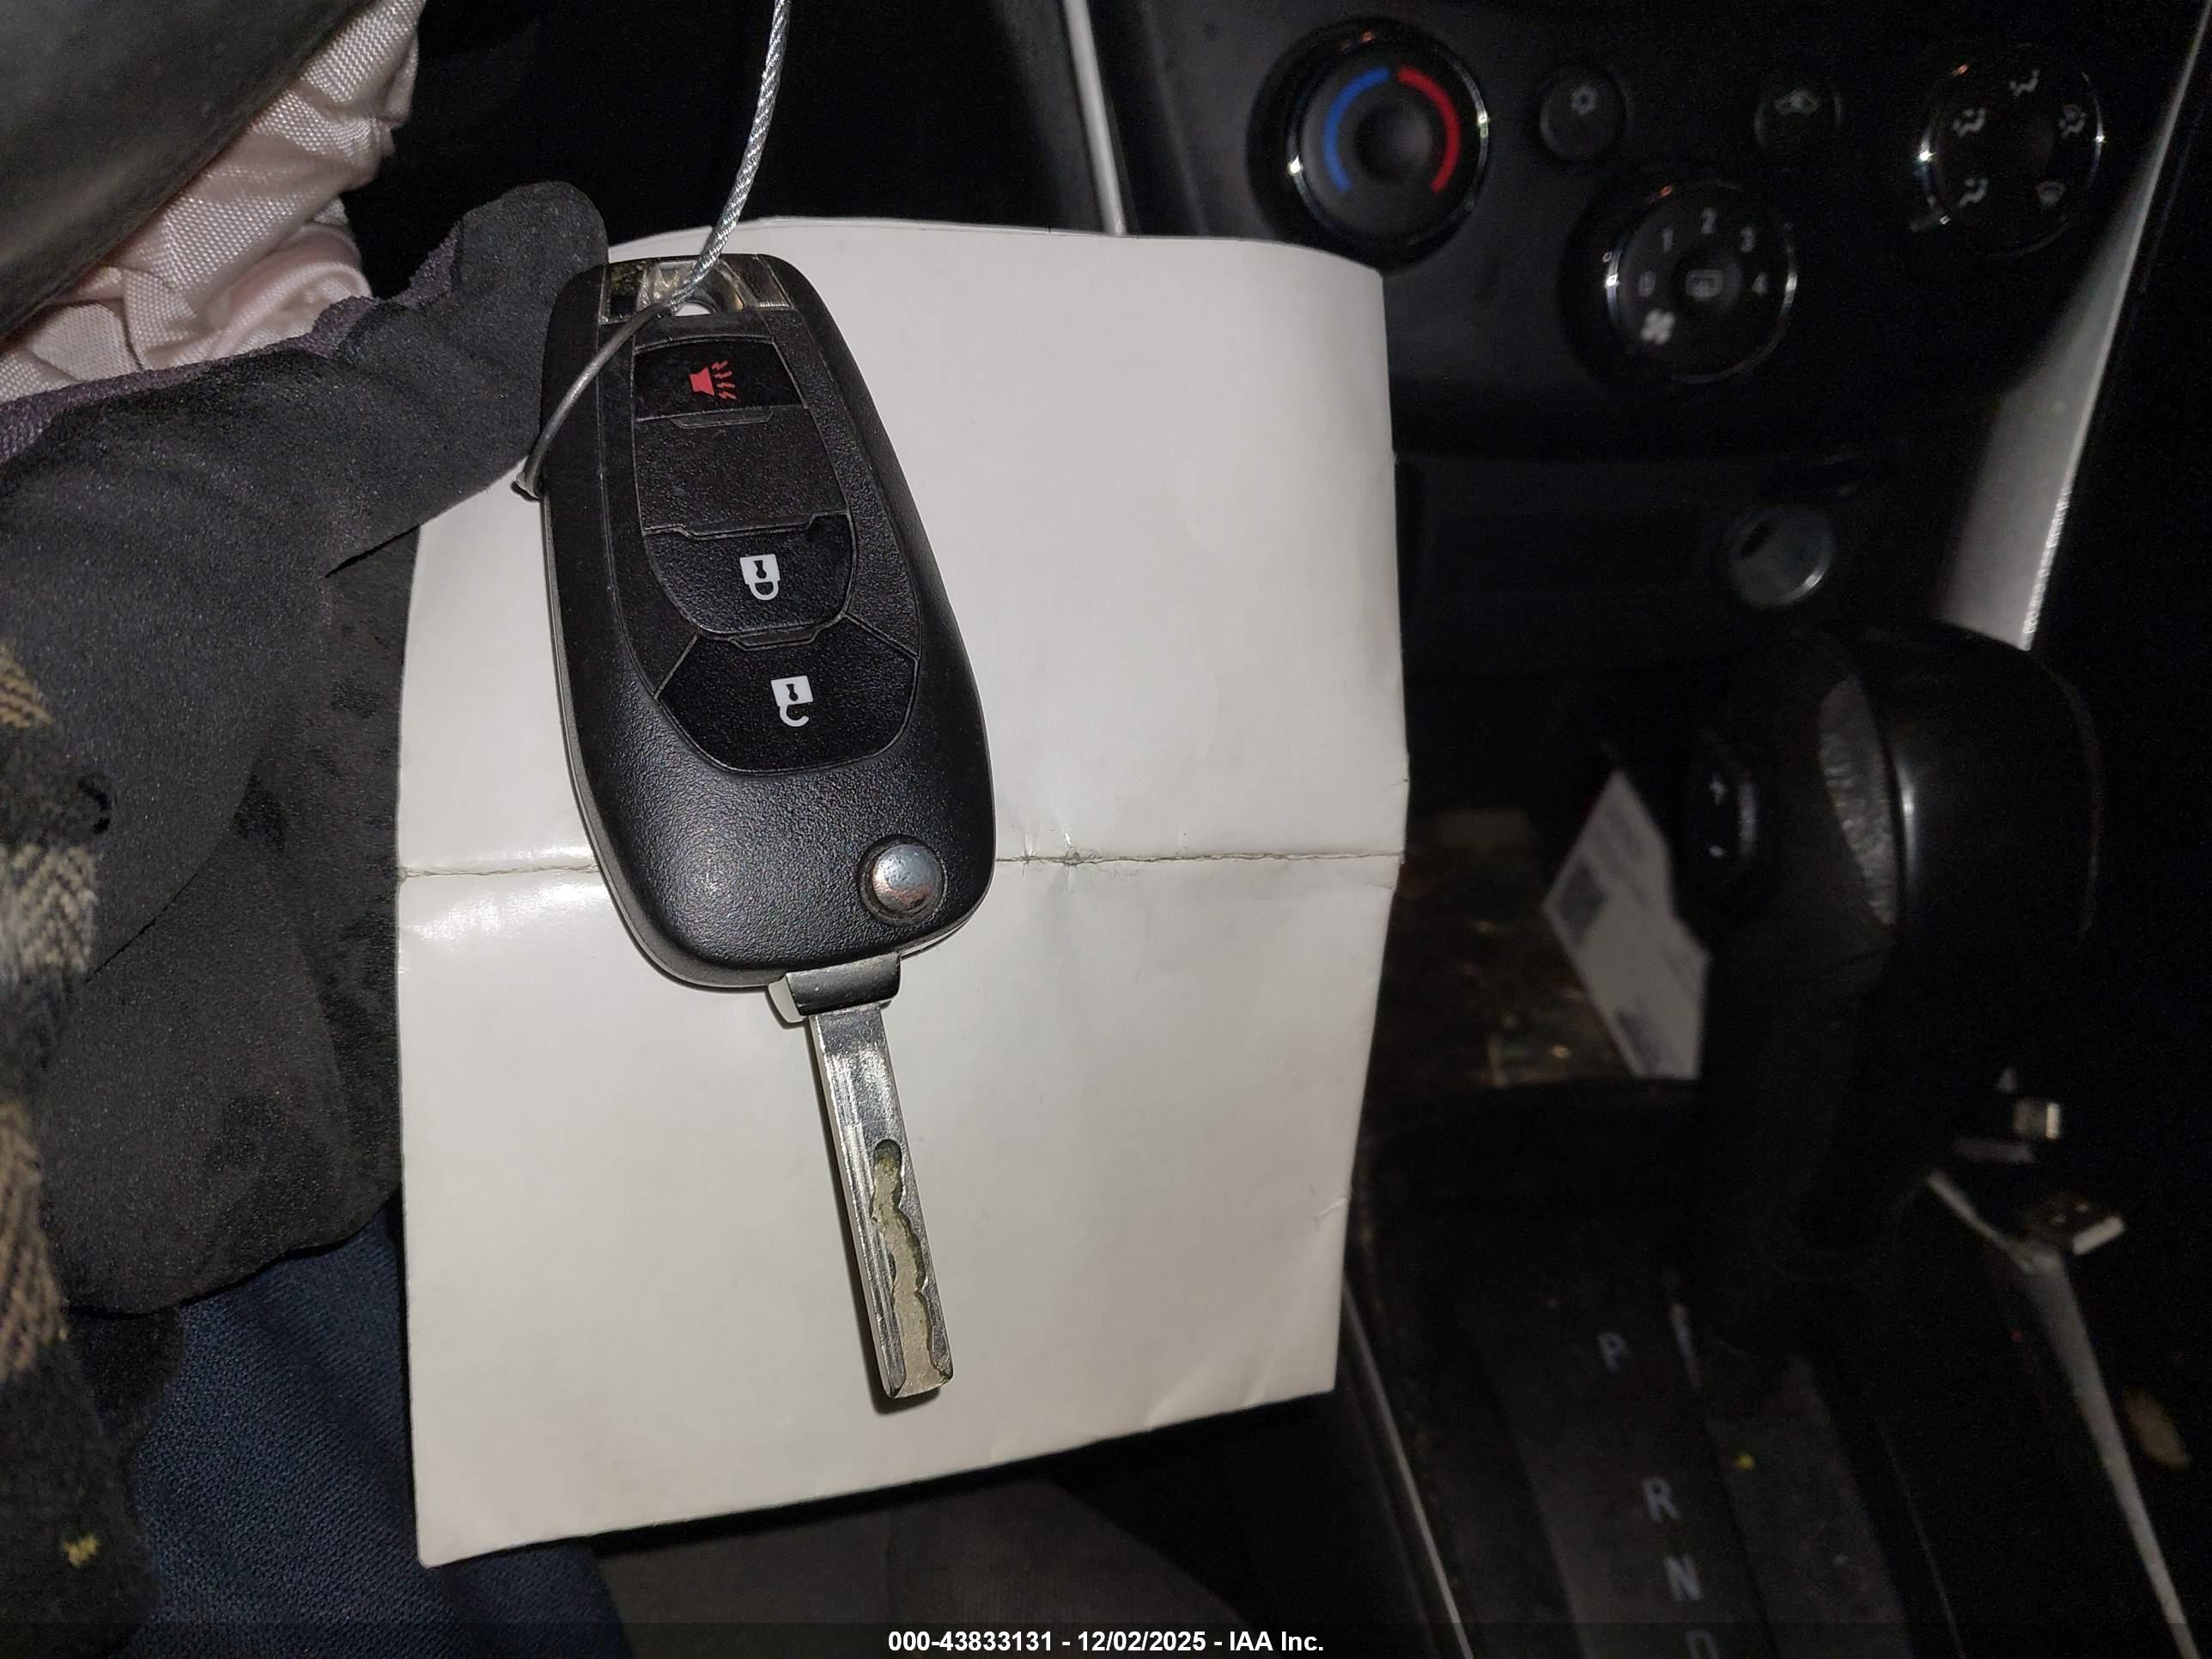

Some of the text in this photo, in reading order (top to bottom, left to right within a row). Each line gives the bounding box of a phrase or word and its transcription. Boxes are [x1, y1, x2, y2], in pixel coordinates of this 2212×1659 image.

[1700, 206, 1717, 234] 2
[1662, 226, 1674, 253] 1
[1739, 225, 1757, 254] 3
[1751, 270, 1770, 297] 4
[1595, 1330, 1629, 1373] P
[1641, 1475, 1682, 1524] R
[1663, 1553, 1705, 1602] N
